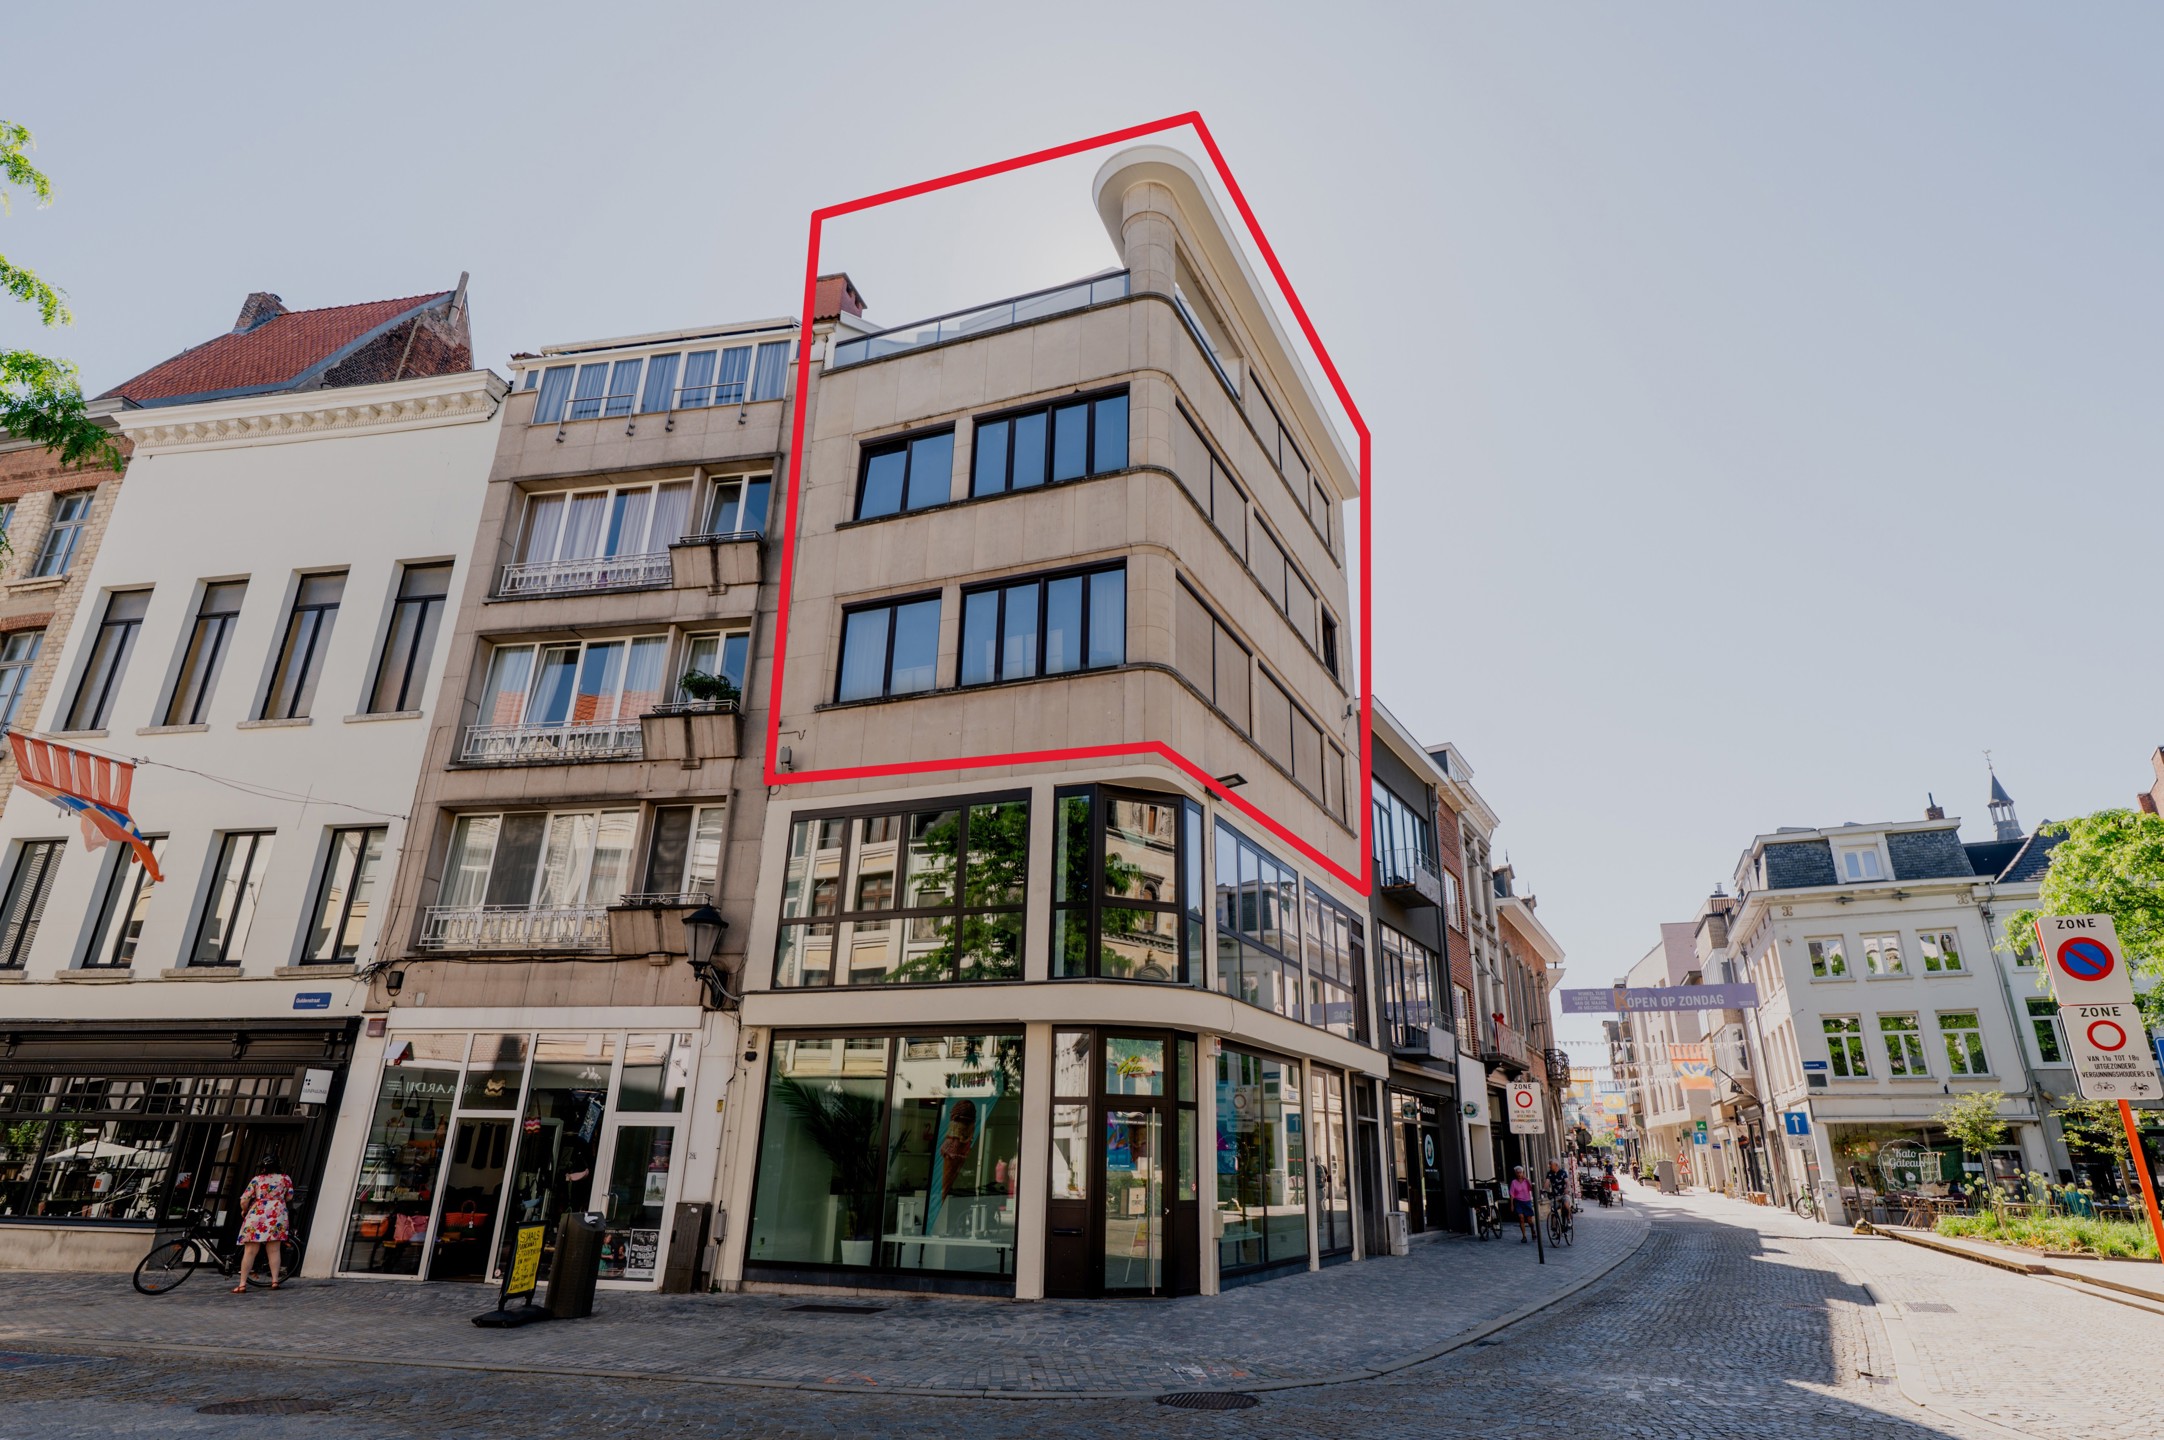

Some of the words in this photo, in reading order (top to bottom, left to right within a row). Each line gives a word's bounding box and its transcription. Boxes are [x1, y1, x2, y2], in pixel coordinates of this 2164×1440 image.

[2056, 918, 2096, 929] ZONE
[1661, 996, 1675, 1007] OP
[1678, 994, 1725, 1007] ZONDAG
[2080, 1007, 2121, 1018] ZONE
[2094, 1062, 2137, 1070] UITGEZONDERD
[2081, 1070, 2145, 1078] VERGUNNINGSHOUDERS
[1894, 1148, 1916, 1158] Kato
